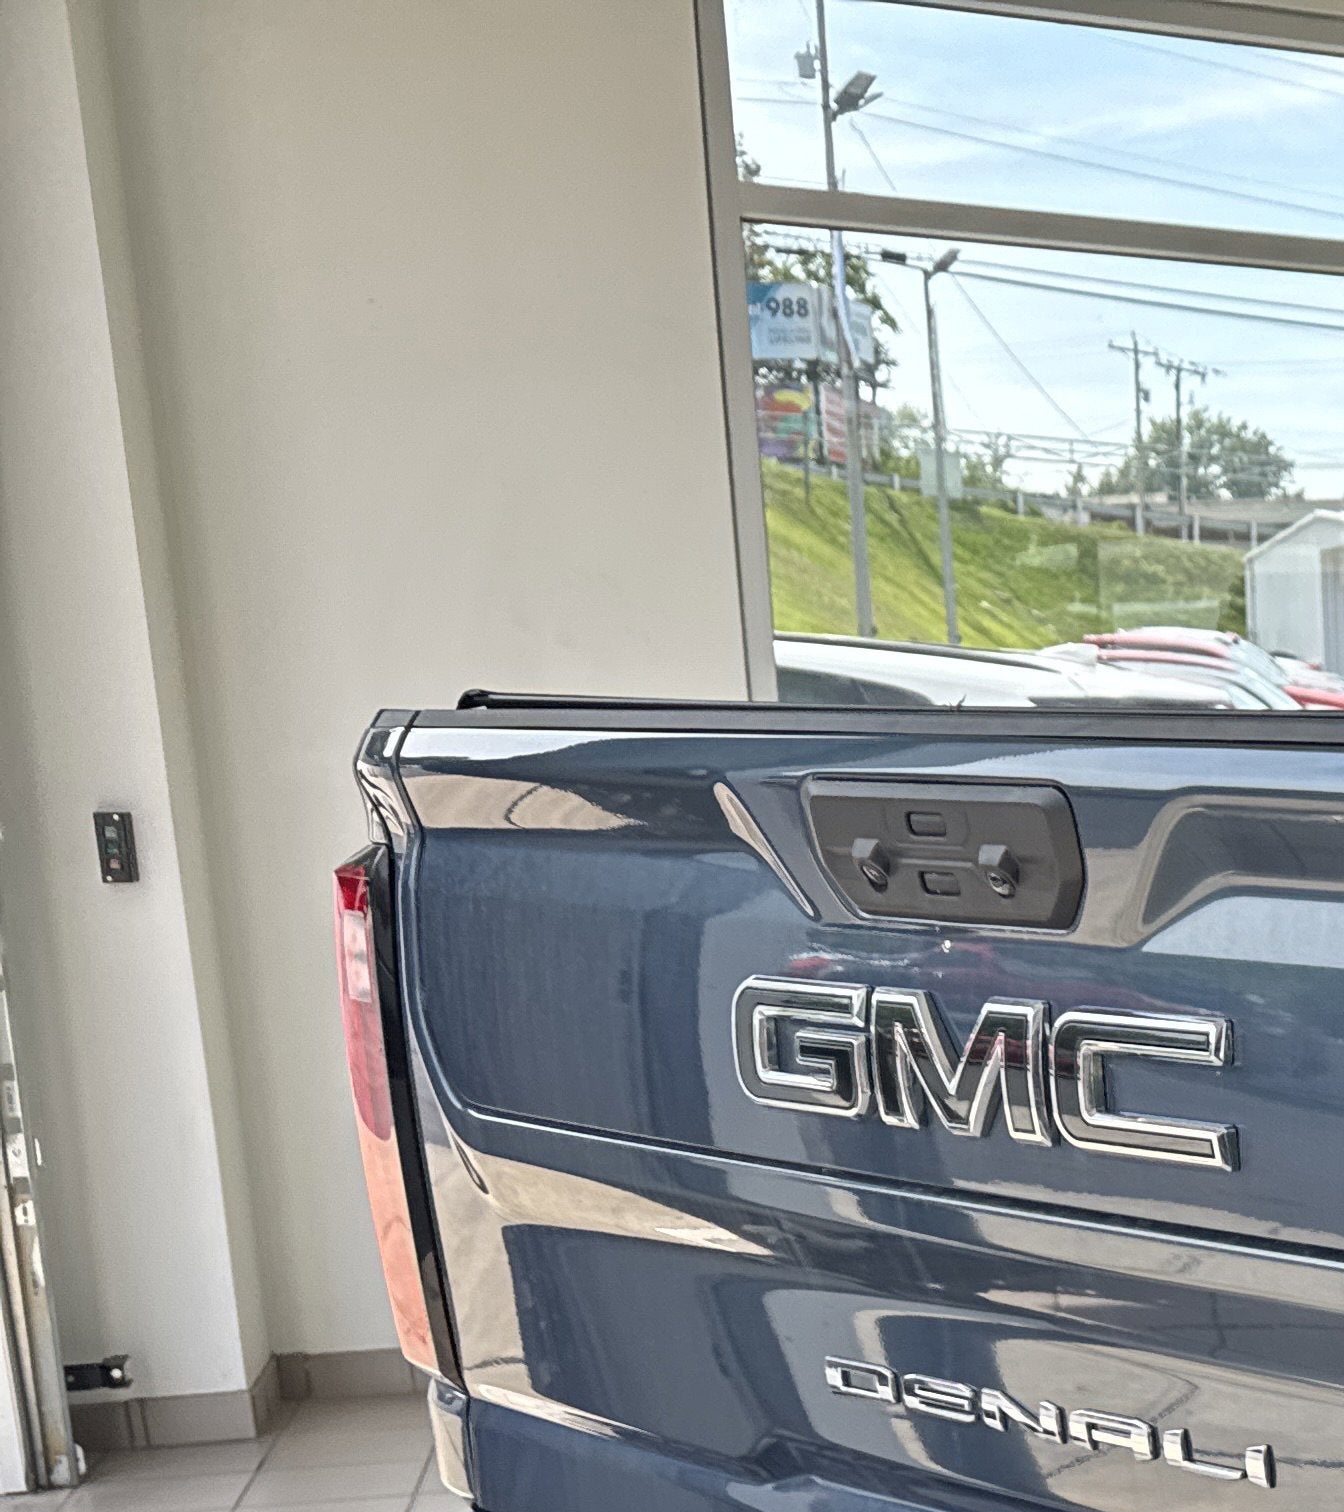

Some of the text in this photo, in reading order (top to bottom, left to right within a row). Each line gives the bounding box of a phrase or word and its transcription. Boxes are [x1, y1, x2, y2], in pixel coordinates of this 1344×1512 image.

[765, 297, 808, 317] 988
[731, 974, 1241, 1172] GMC
[824, 1355, 1277, 1489] DENALI
